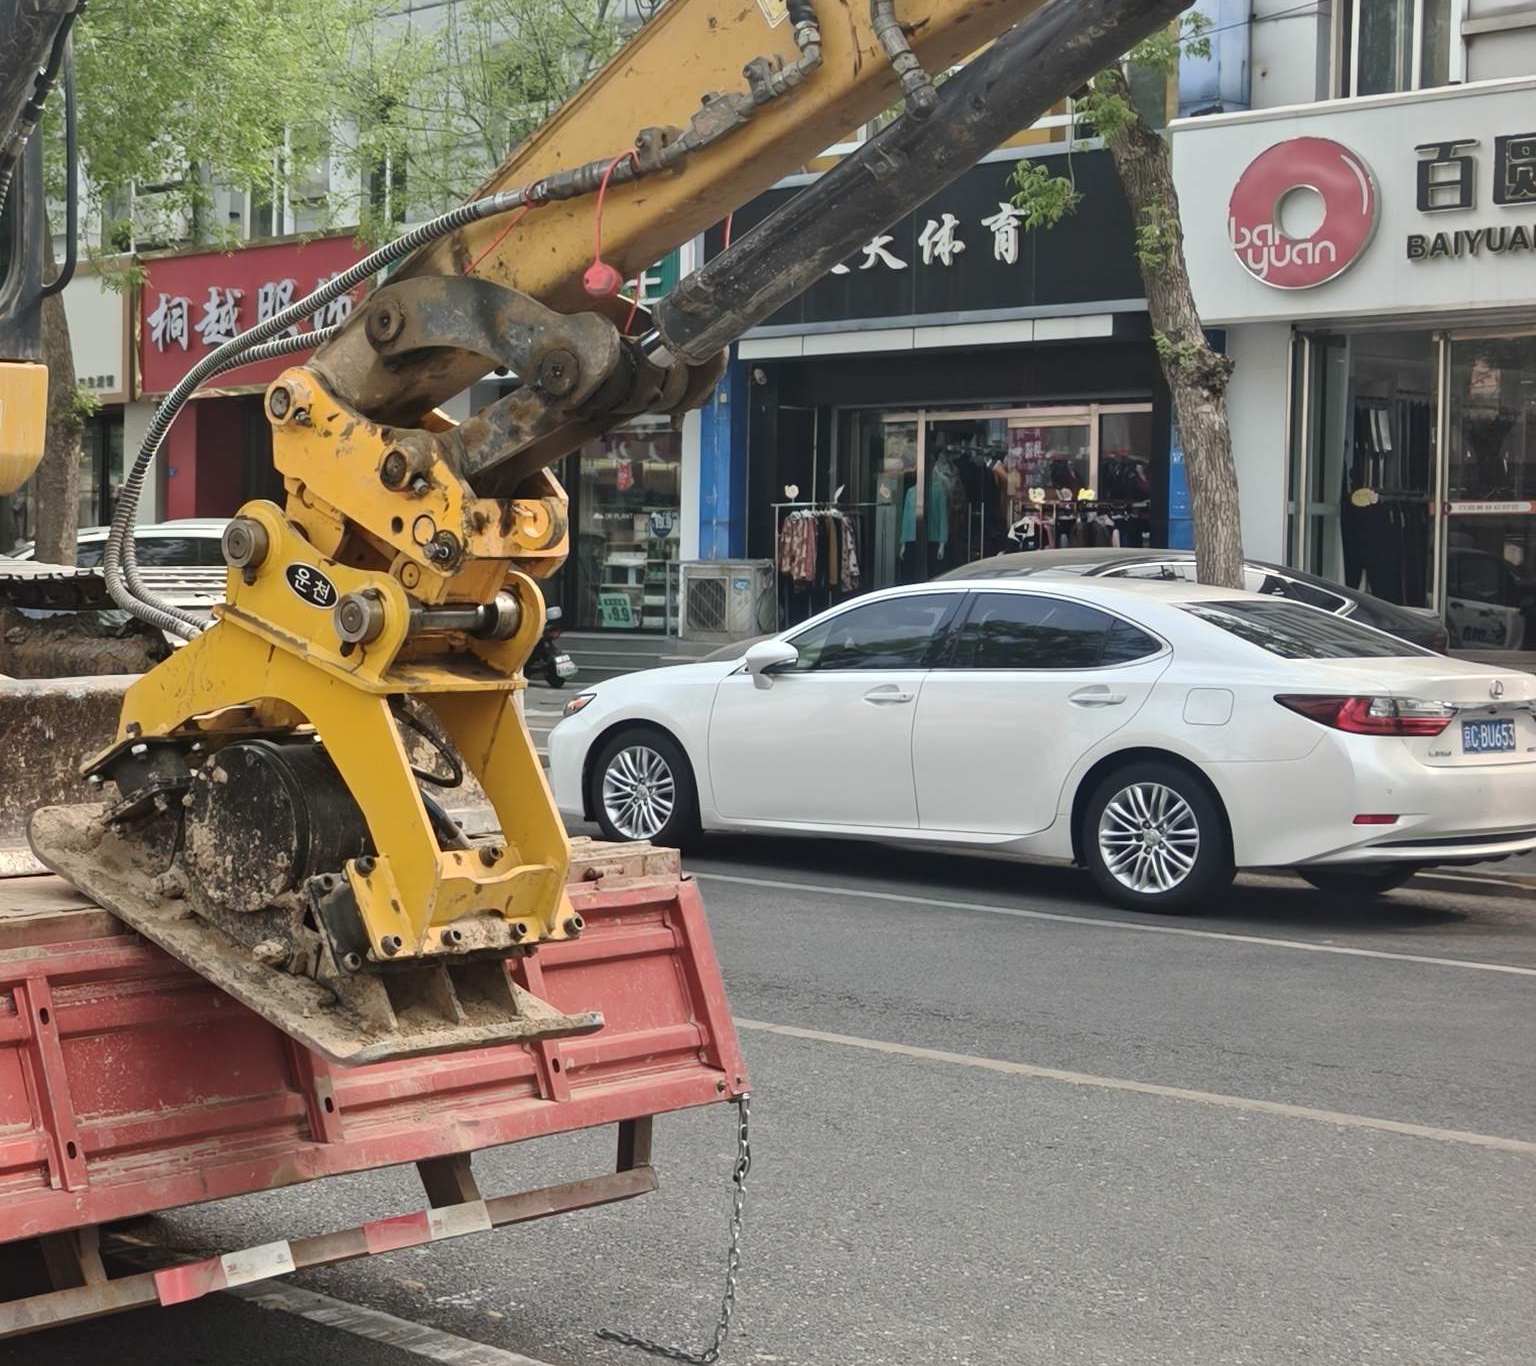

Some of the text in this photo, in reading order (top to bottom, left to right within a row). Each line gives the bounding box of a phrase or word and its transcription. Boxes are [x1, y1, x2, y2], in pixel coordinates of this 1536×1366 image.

[1247, 240, 1337, 278] yuan
[1407, 223, 1536, 259] BAIYUA
[295, 568, 331, 604] 운천
